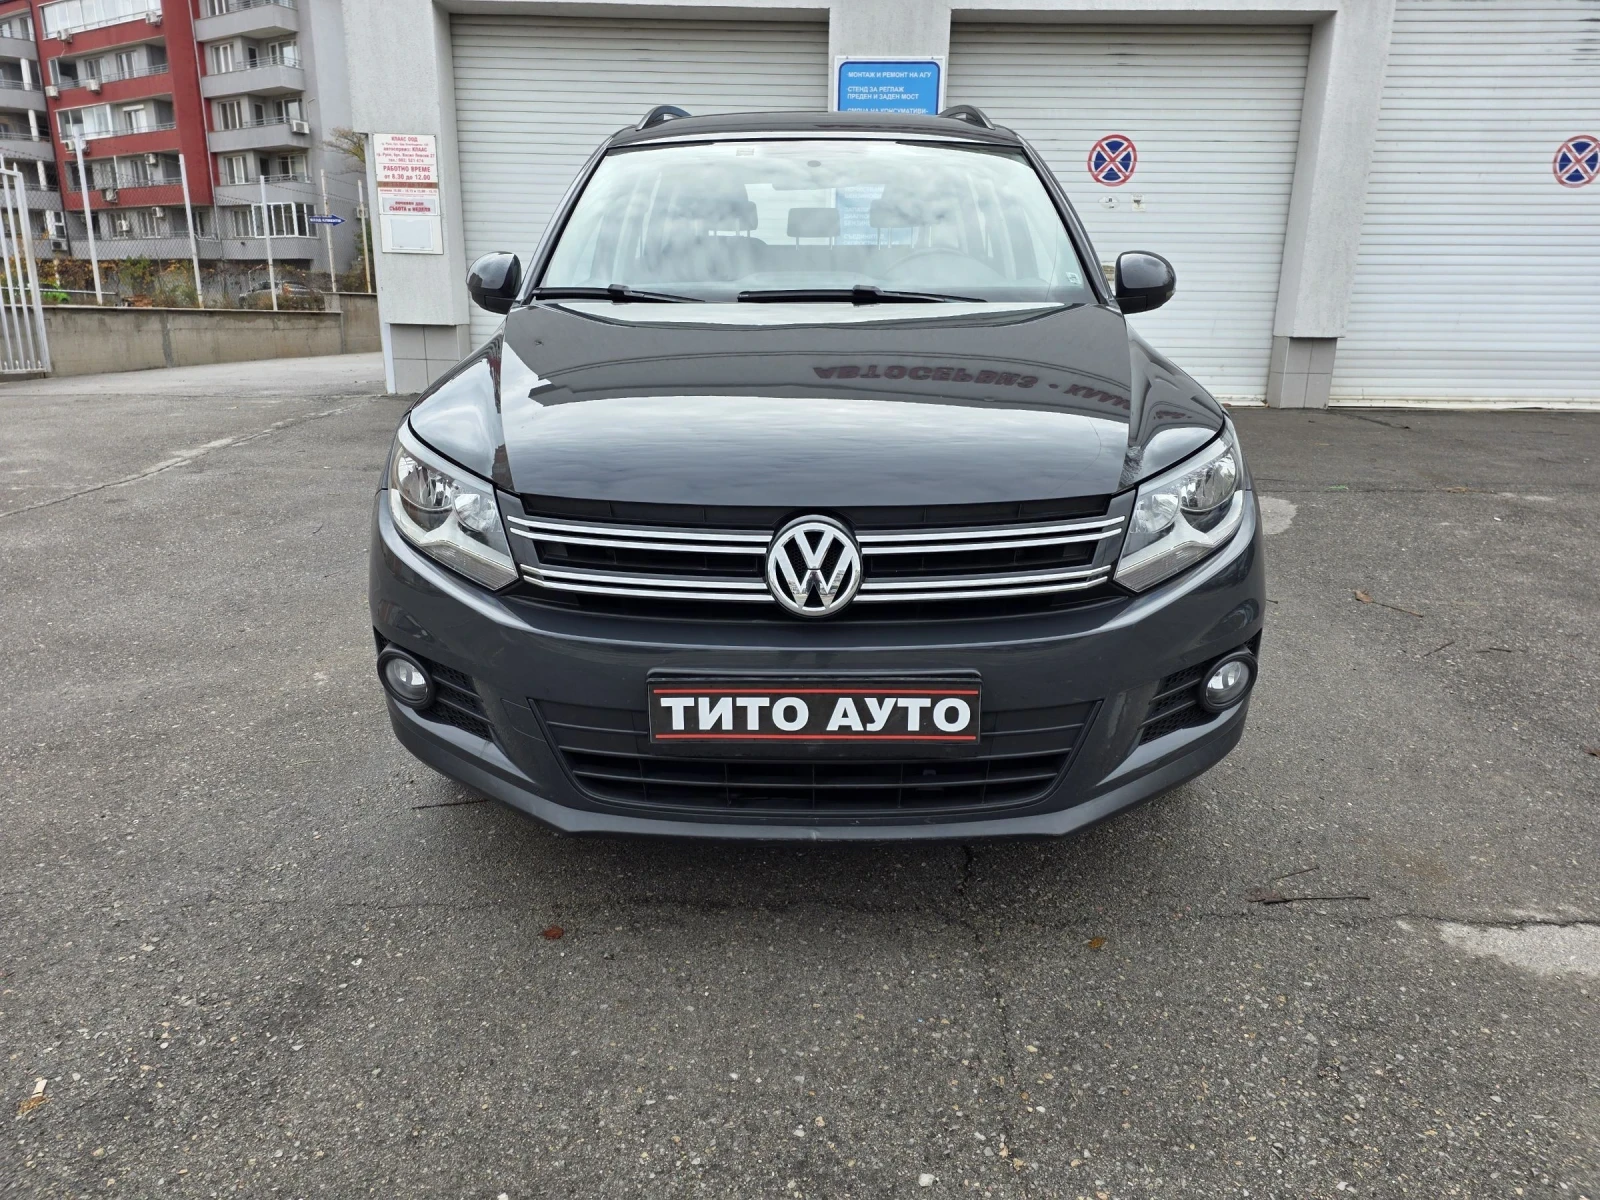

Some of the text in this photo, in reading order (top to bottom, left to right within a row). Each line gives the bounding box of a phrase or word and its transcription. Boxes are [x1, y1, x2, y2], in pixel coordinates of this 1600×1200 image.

[769, 524, 859, 614] VW
[660, 696, 971, 733] ТИТО АУТО
